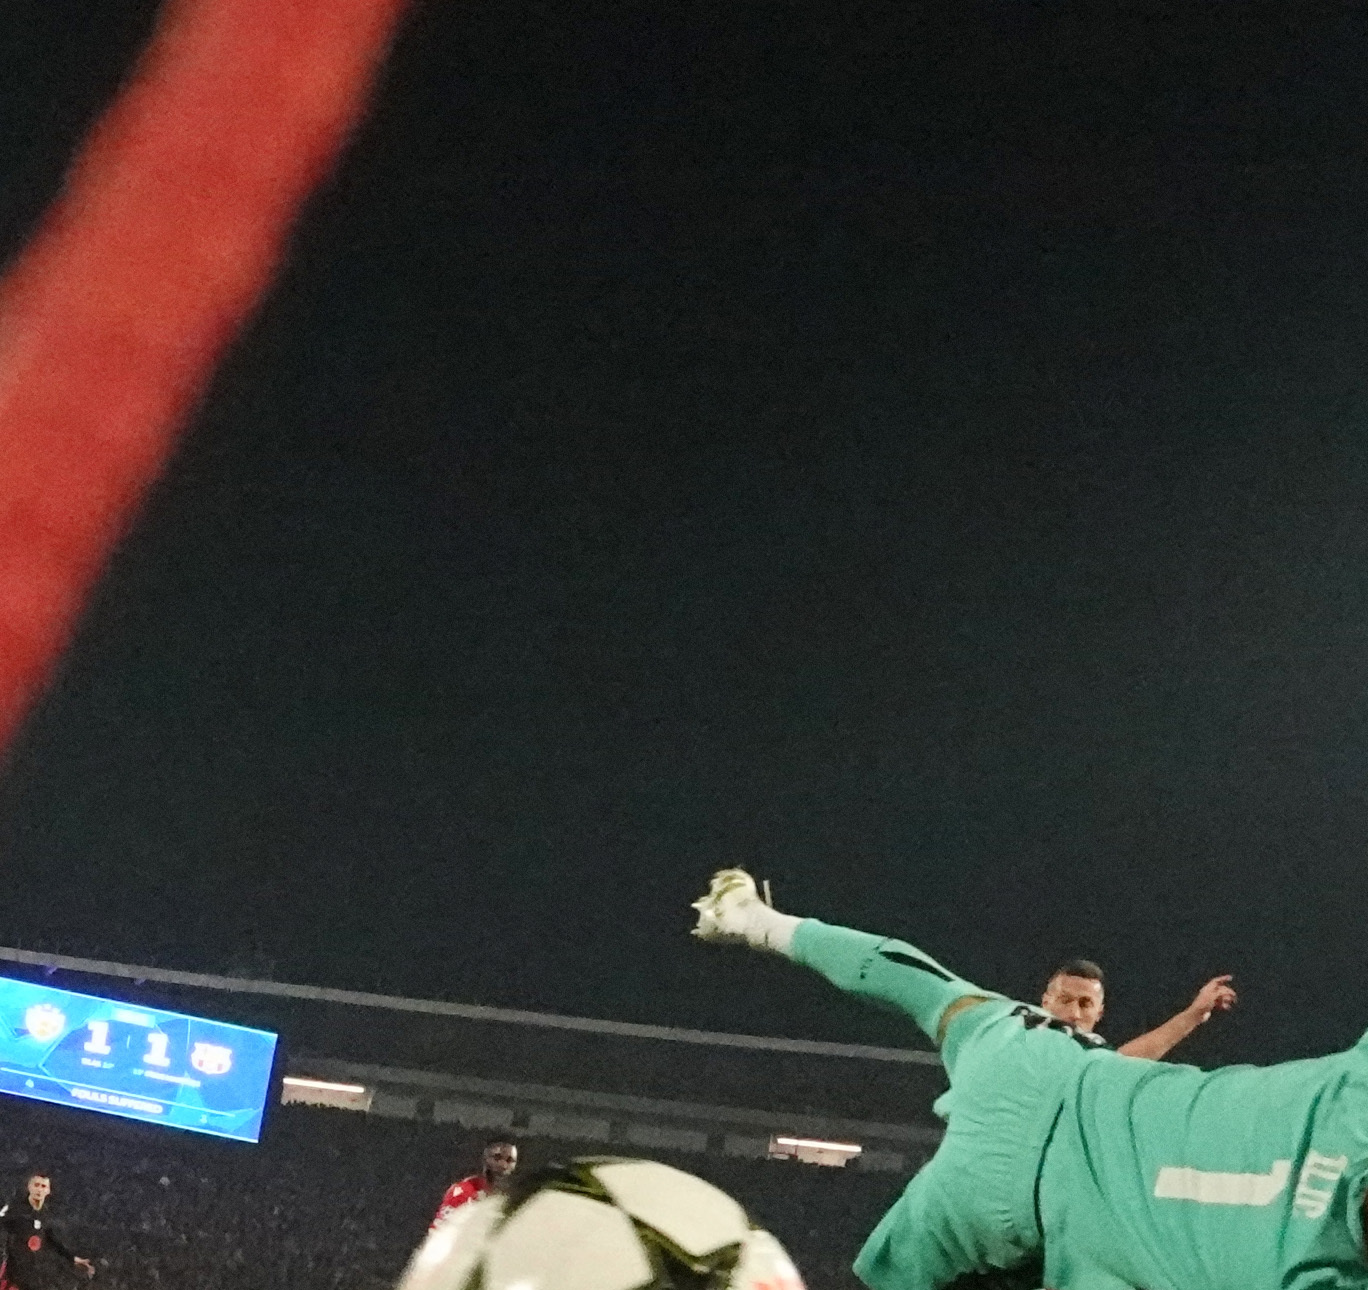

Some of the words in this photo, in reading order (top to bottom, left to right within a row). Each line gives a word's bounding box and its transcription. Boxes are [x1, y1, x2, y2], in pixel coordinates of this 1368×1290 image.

[84, 1020, 112, 1055] 1
[143, 1032, 171, 1067] 1
[1154, 1159, 1292, 1206] 1
